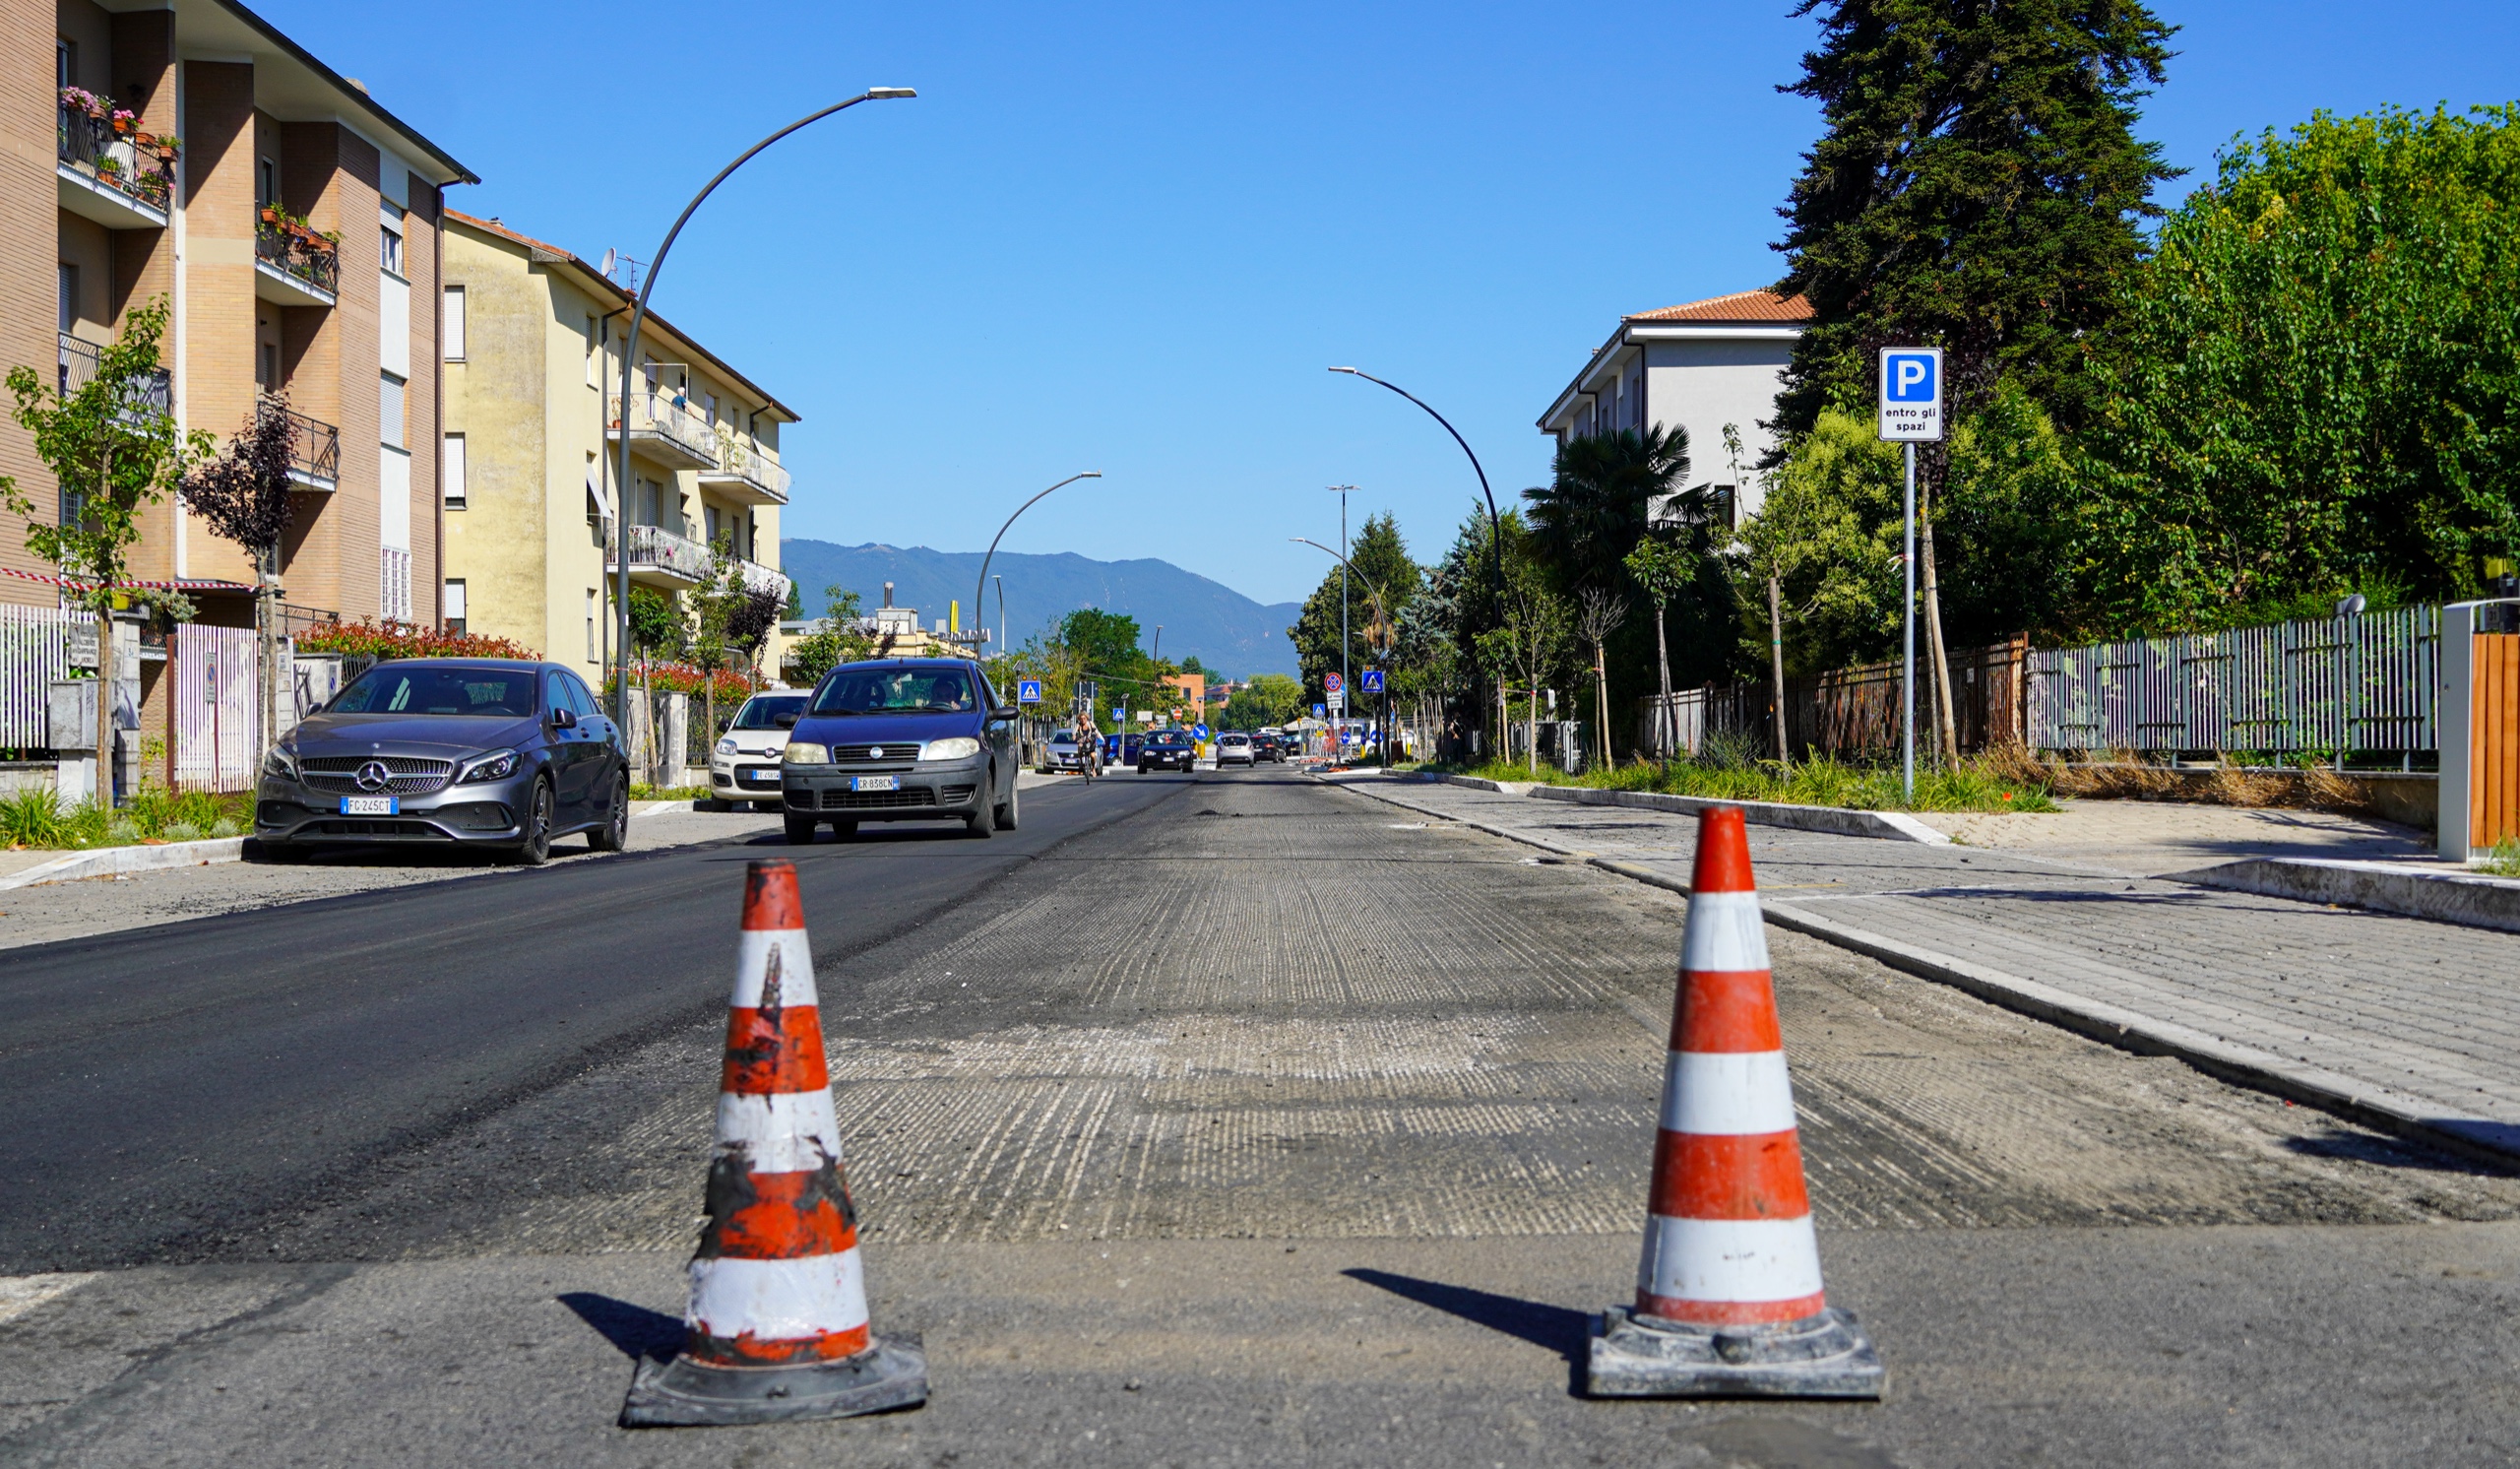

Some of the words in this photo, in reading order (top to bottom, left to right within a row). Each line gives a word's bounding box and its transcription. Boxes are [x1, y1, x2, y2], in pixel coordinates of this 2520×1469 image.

[1897, 359, 1926, 397] P
[1885, 408, 1918, 417] entro
[1922, 408, 1936, 419] gli
[1896, 421, 1925, 432] spazi
